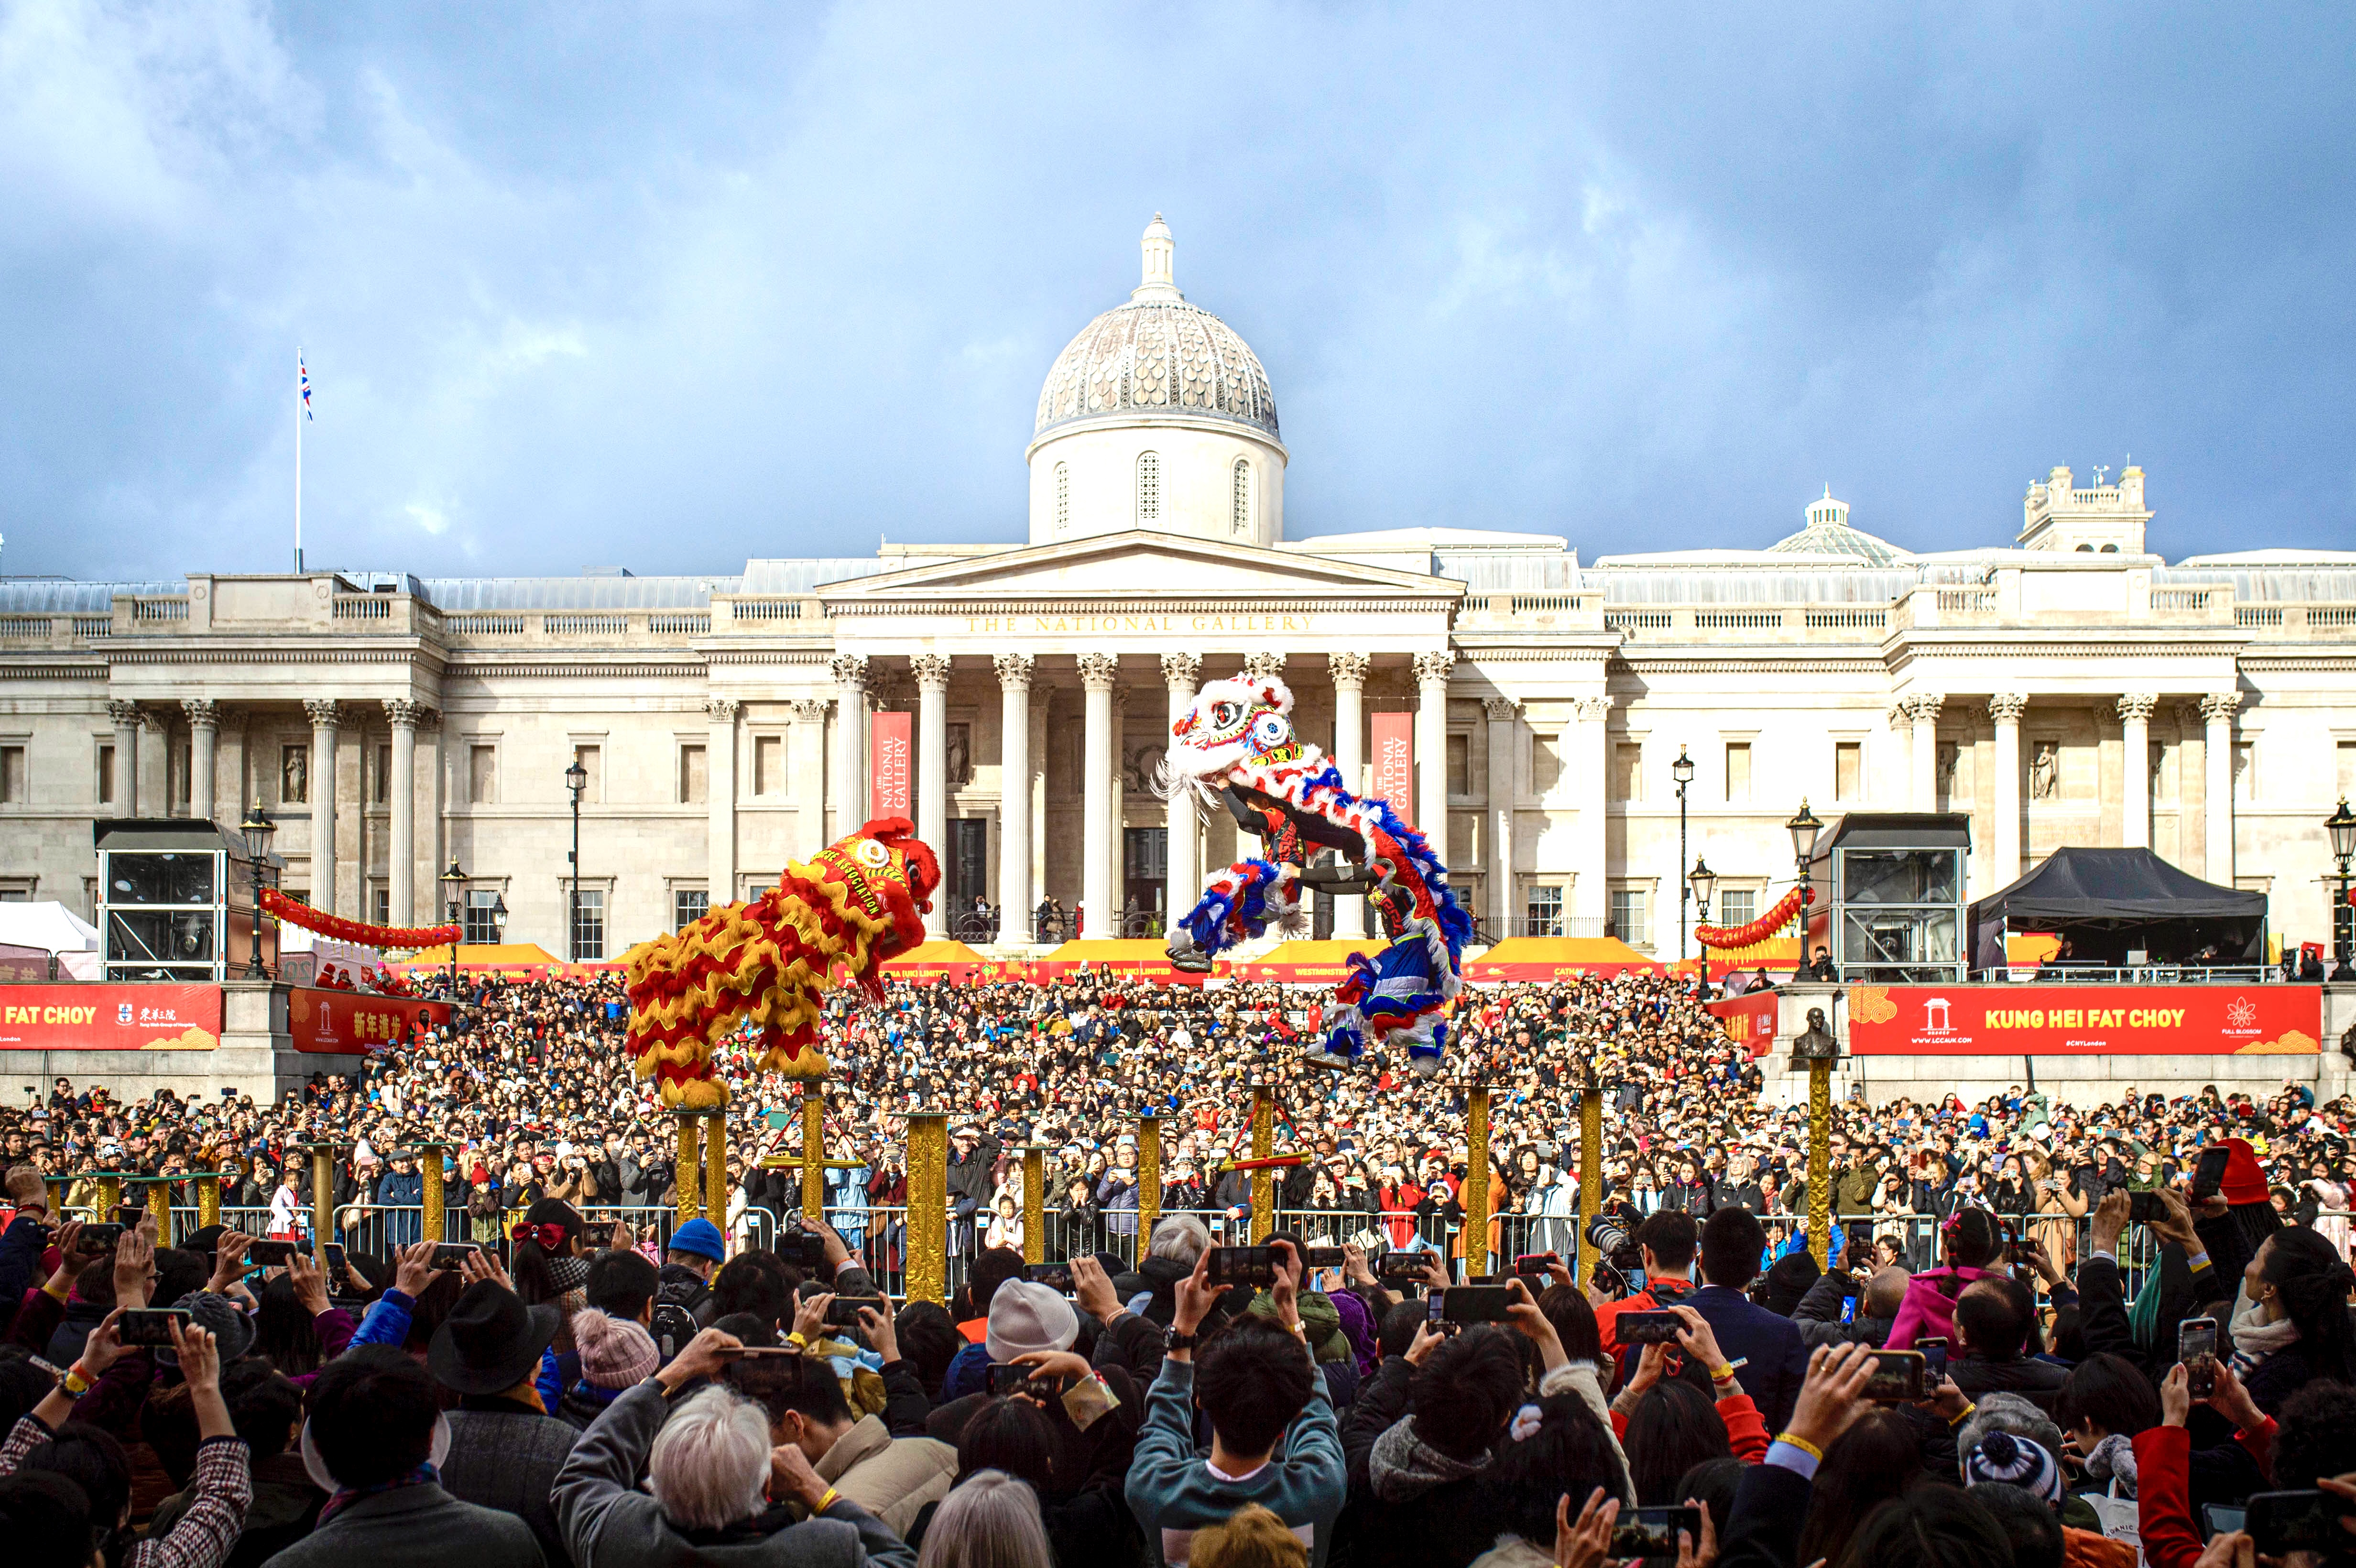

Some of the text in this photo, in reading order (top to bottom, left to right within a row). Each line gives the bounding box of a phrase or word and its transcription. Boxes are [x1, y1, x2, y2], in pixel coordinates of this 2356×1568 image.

[966, 616, 1314, 632] THE NATIONAL GALLERY
[883, 736, 893, 808] NATIONAL
[894, 737, 906, 809] GALLERY
[1395, 737, 1407, 809] GALLERY
[835, 858, 879, 915] ASSOCIATION
[5, 1006, 42, 1024] FAT
[43, 1006, 97, 1024] CHOY
[1985, 1009, 2185, 1029] KUNG HEI FAT CHOY
[2105, 1524, 2134, 1538] RGANIC
